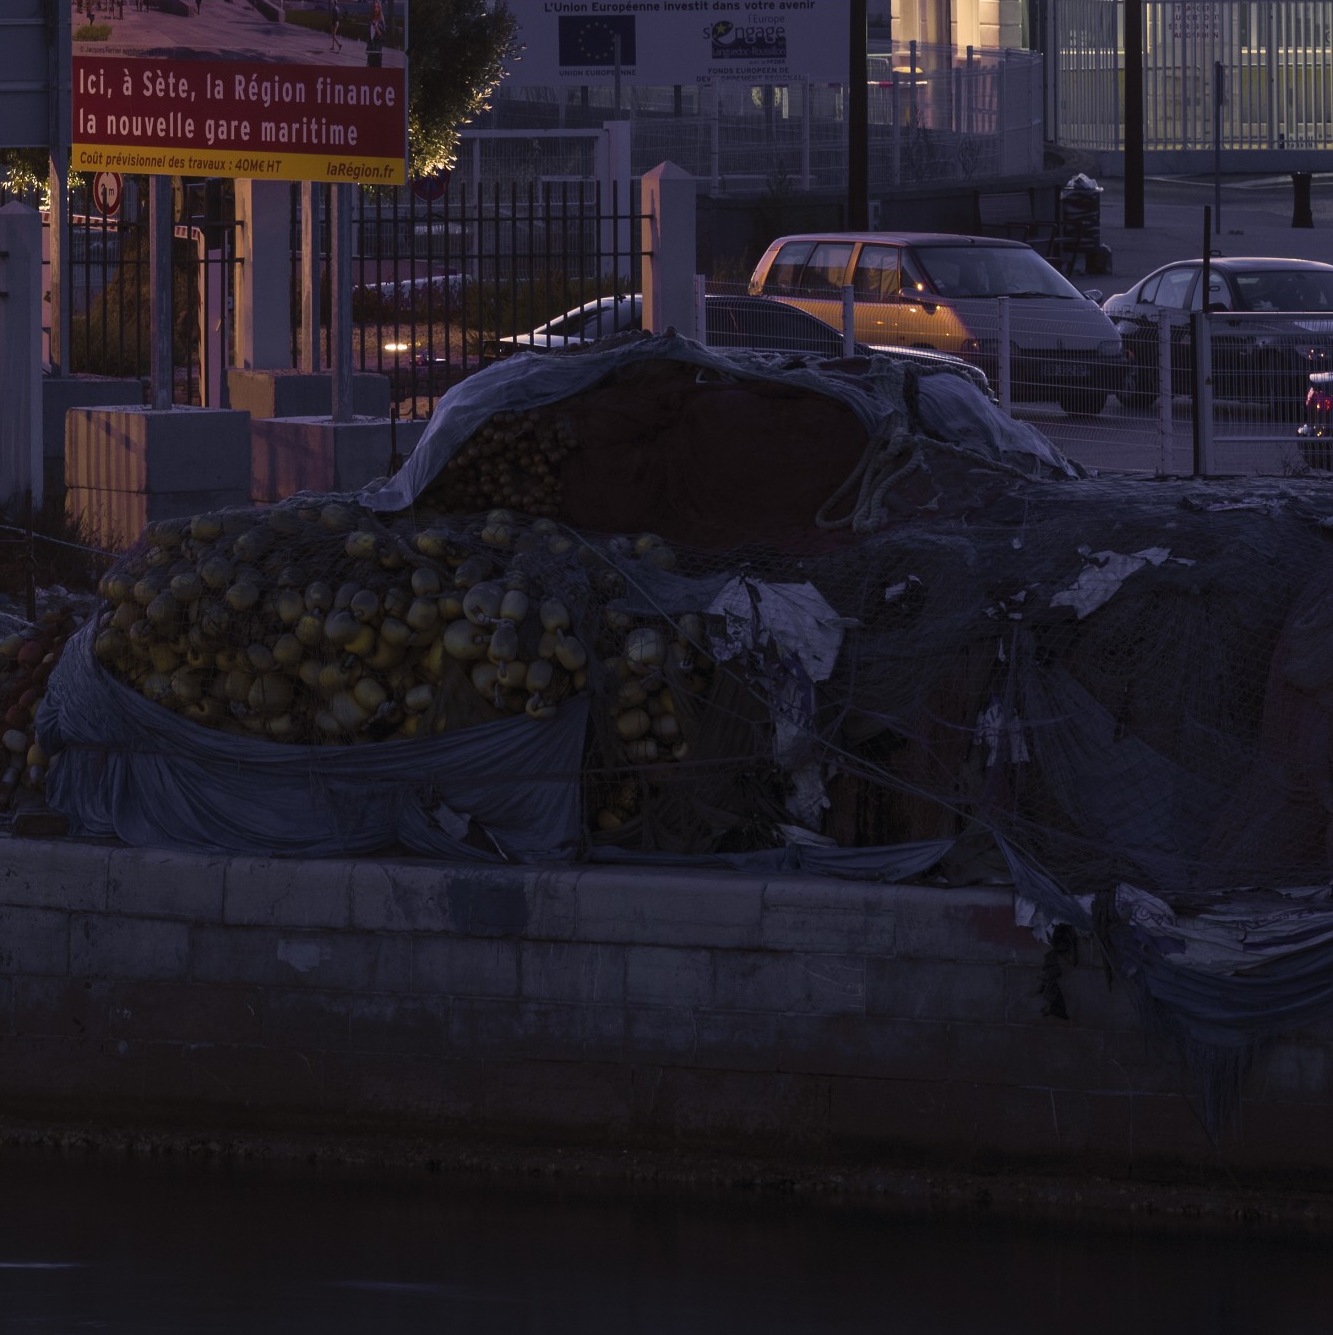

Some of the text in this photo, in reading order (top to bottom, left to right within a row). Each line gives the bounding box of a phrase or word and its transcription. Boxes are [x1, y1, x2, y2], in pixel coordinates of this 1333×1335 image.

[544, 0, 816, 14] L'Union Européenne investit dans votre avenir
[559, 69, 583, 77] UNION
[79, 68, 396, 107] Ici, à Sète, la Région finance
[79, 108, 358, 145] la nouvelle gare maritime
[80, 152, 103, 166] Coût
[105, 153, 166, 169] prévisionnel
[168, 156, 186, 169] des
[188, 158, 226, 171] travaux
[267, 161, 283, 173] HT
[326, 162, 395, 181] laRégion.fr
